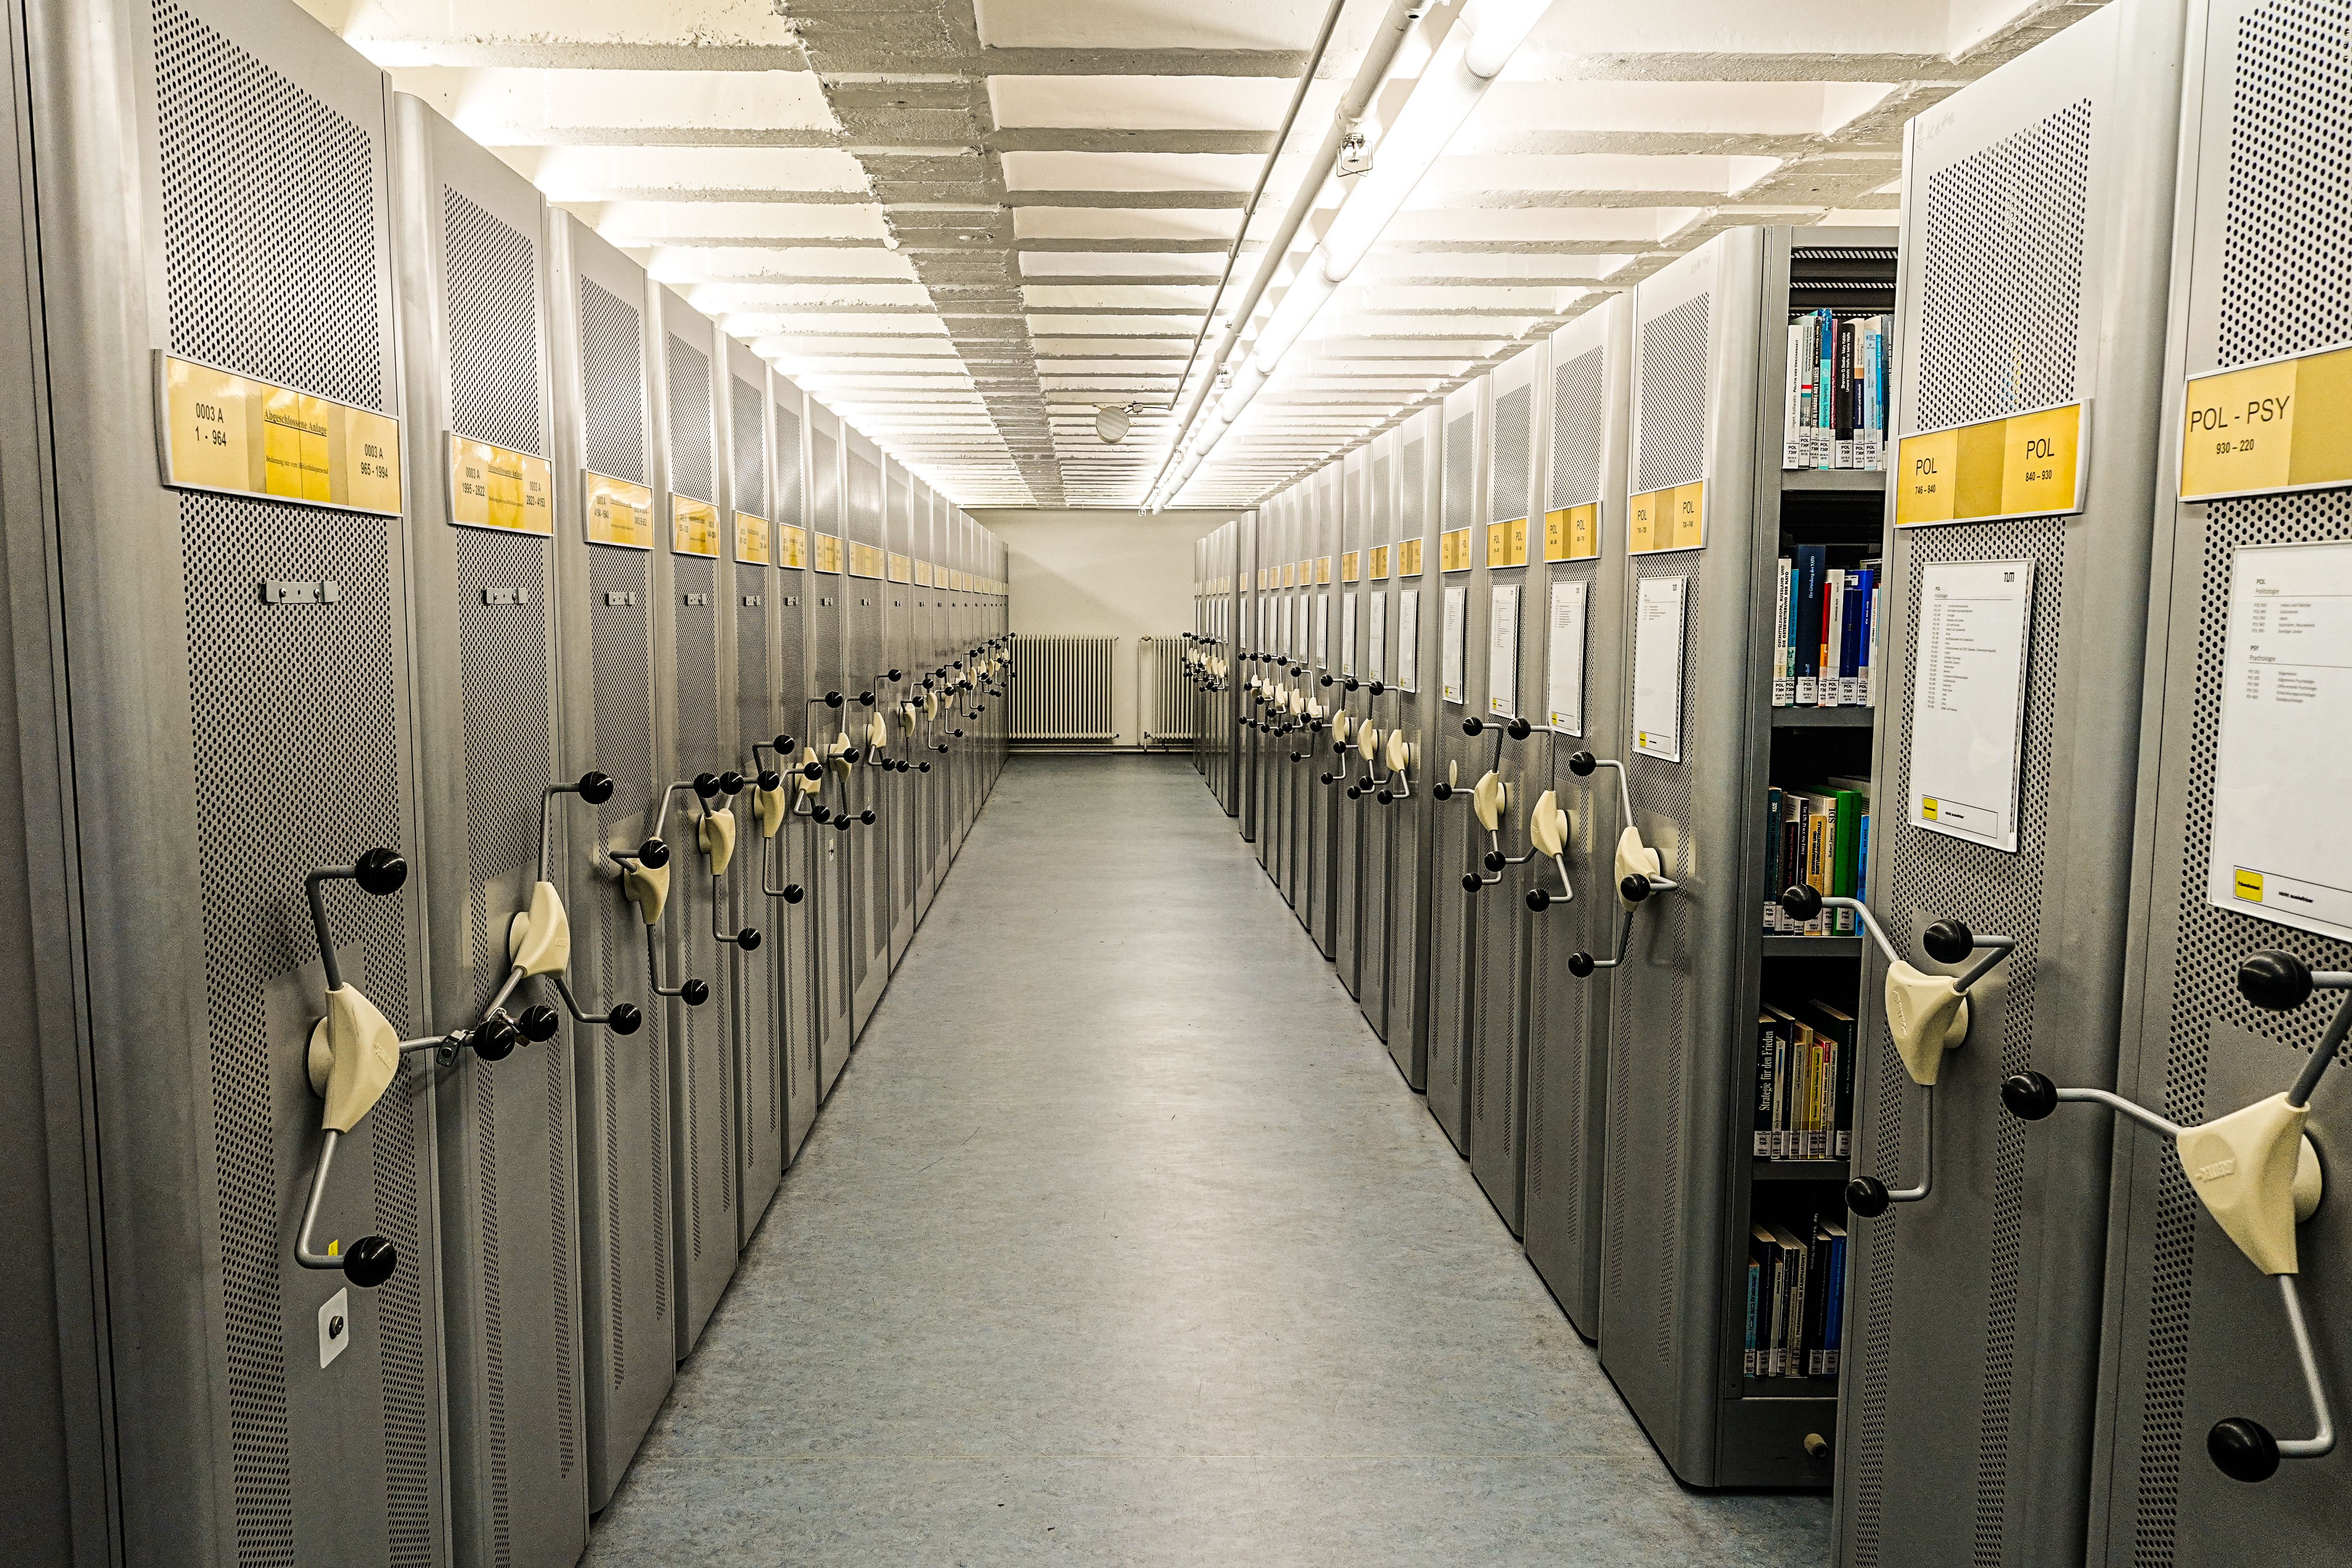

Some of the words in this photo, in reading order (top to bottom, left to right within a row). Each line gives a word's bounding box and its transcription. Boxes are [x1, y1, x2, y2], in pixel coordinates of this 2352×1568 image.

[196, 403, 214, 421] 0003
[218, 408, 224, 423] A
[2191, 407, 2227, 432] POL
[2247, 396, 2290, 424] PSY
[264, 409, 307, 430] Abgeschlossene
[309, 423, 327, 434] Anlage
[196, 426, 199, 441] 1
[213, 430, 226, 446] 964
[365, 444, 377, 458] 0003
[379, 447, 383, 459] A
[2026, 438, 2055, 459] POL
[2216, 442, 2230, 455] 930
[2239, 439, 2254, 451] 220
[361, 462, 370, 475] 965
[376, 465, 388, 479] 1994
[466, 467, 475, 479] 0003
[477, 469, 480, 480] A
[1916, 457, 1937, 475] POL
[2025, 471, 2035, 481] 840
[2042, 469, 2052, 480] 930
[462, 482, 472, 494] 1995
[475, 485, 485, 496] 2822
[539, 483, 541, 492] A
[1638, 510, 1647, 521] POL
[1683, 501, 1694, 514] POL
[1762, 1031, 1773, 1055] Frieden
[1762, 1057, 1772, 1068] den
[1761, 1070, 1771, 1080] für
[1759, 1083, 1773, 1111] Strategie
